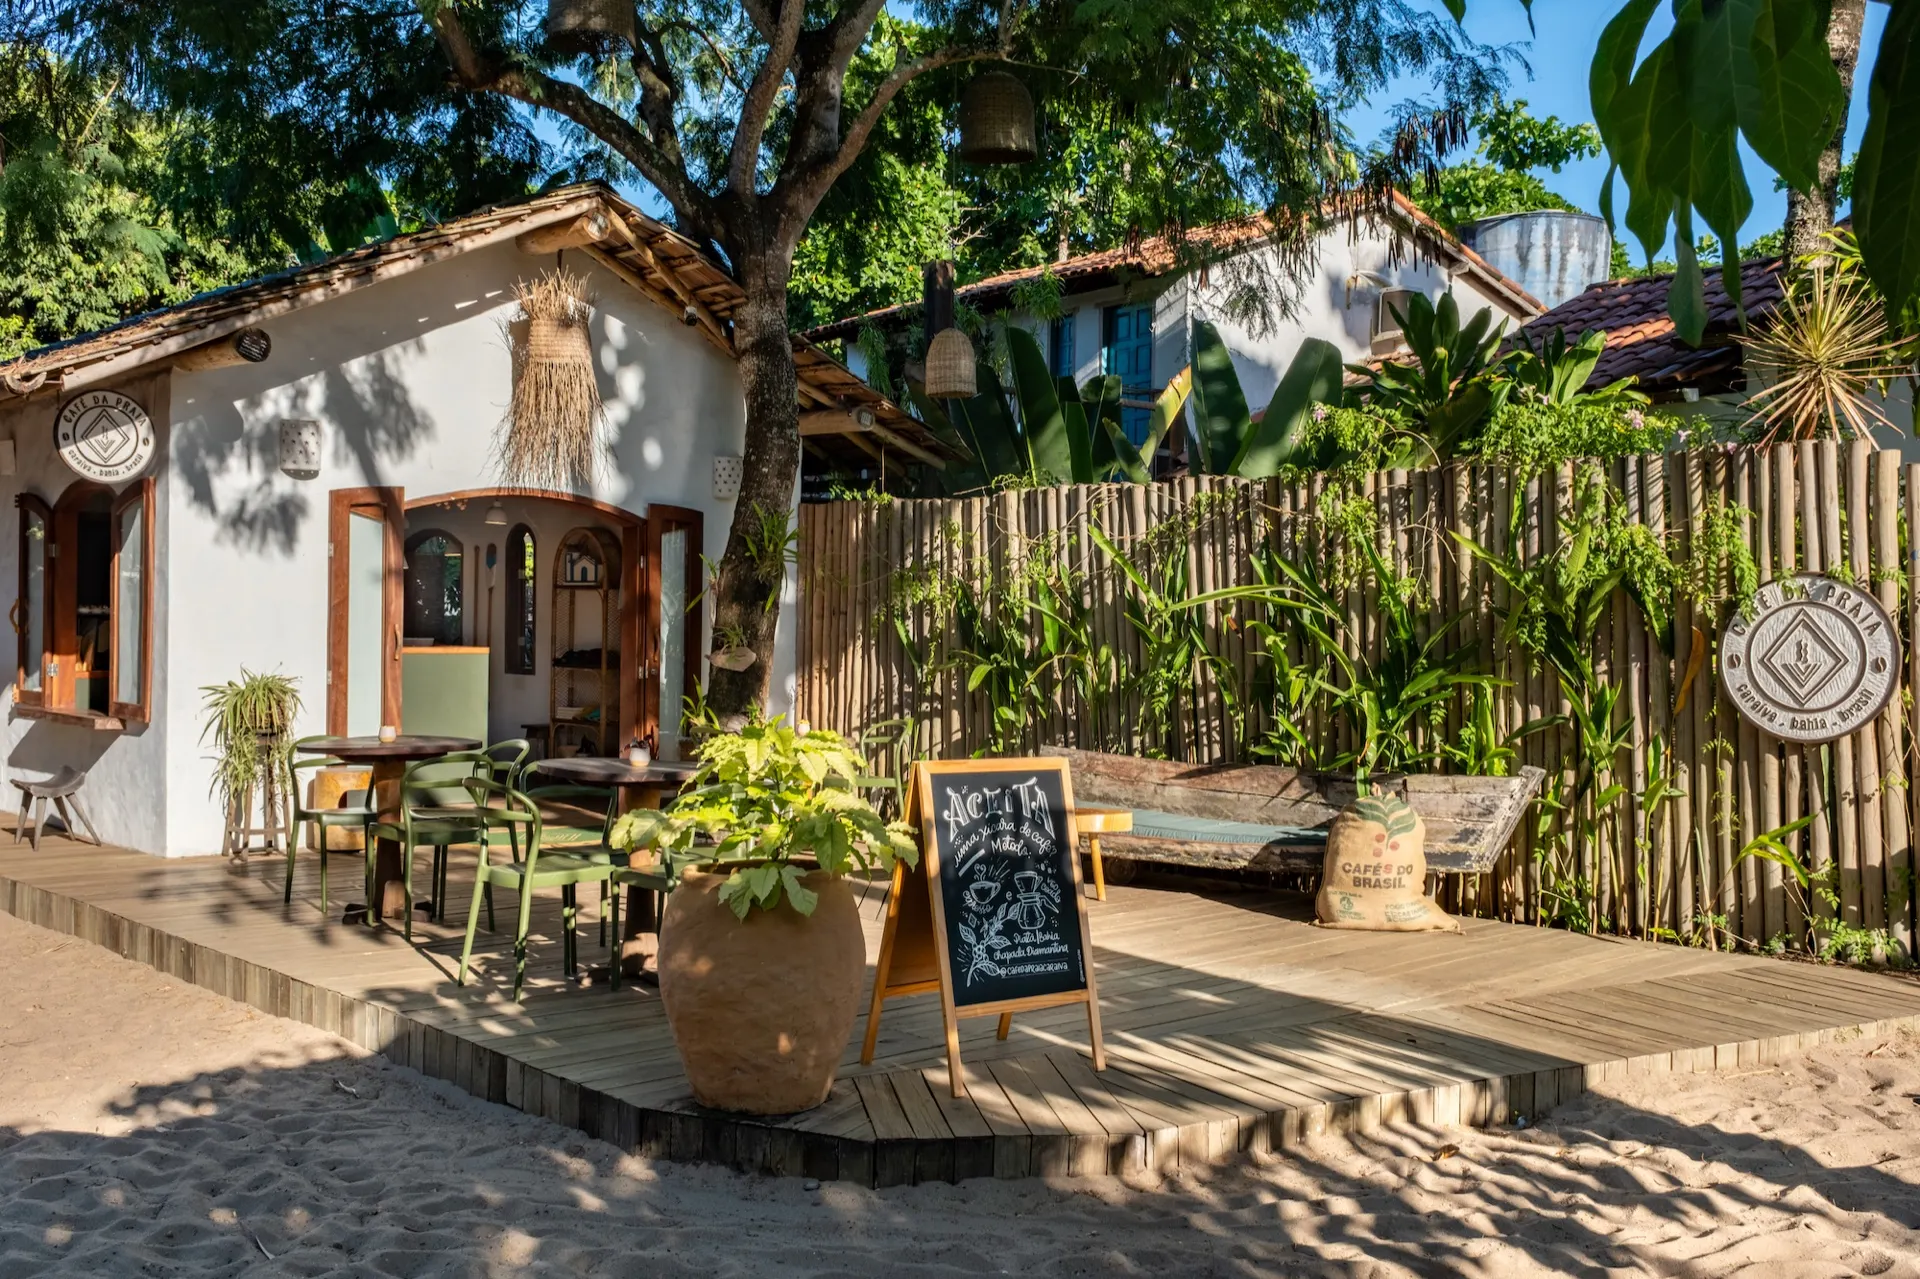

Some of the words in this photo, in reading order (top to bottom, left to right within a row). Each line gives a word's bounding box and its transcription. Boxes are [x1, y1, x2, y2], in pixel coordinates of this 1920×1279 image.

[63, 398, 88, 424] CAFÉ
[92, 395, 109, 405] DA
[115, 398, 147, 427] PRAIA
[68, 449, 92, 472] caraiva
[99, 468, 120, 477] bahia
[126, 454, 144, 471] brasil
[1827, 584, 1883, 637] PRAIA
[1736, 684, 1778, 723] caraiva
[1790, 717, 1828, 730] bahia
[1841, 689, 1875, 721] brasil
[954, 834, 980, 868] uma
[1019, 821, 1031, 837] de
[1341, 861, 1393, 877] CAFÉS
[1396, 863, 1414, 875] DO
[1352, 875, 1406, 889] BRASIL
[1026, 942, 1069, 958] Diamantina
